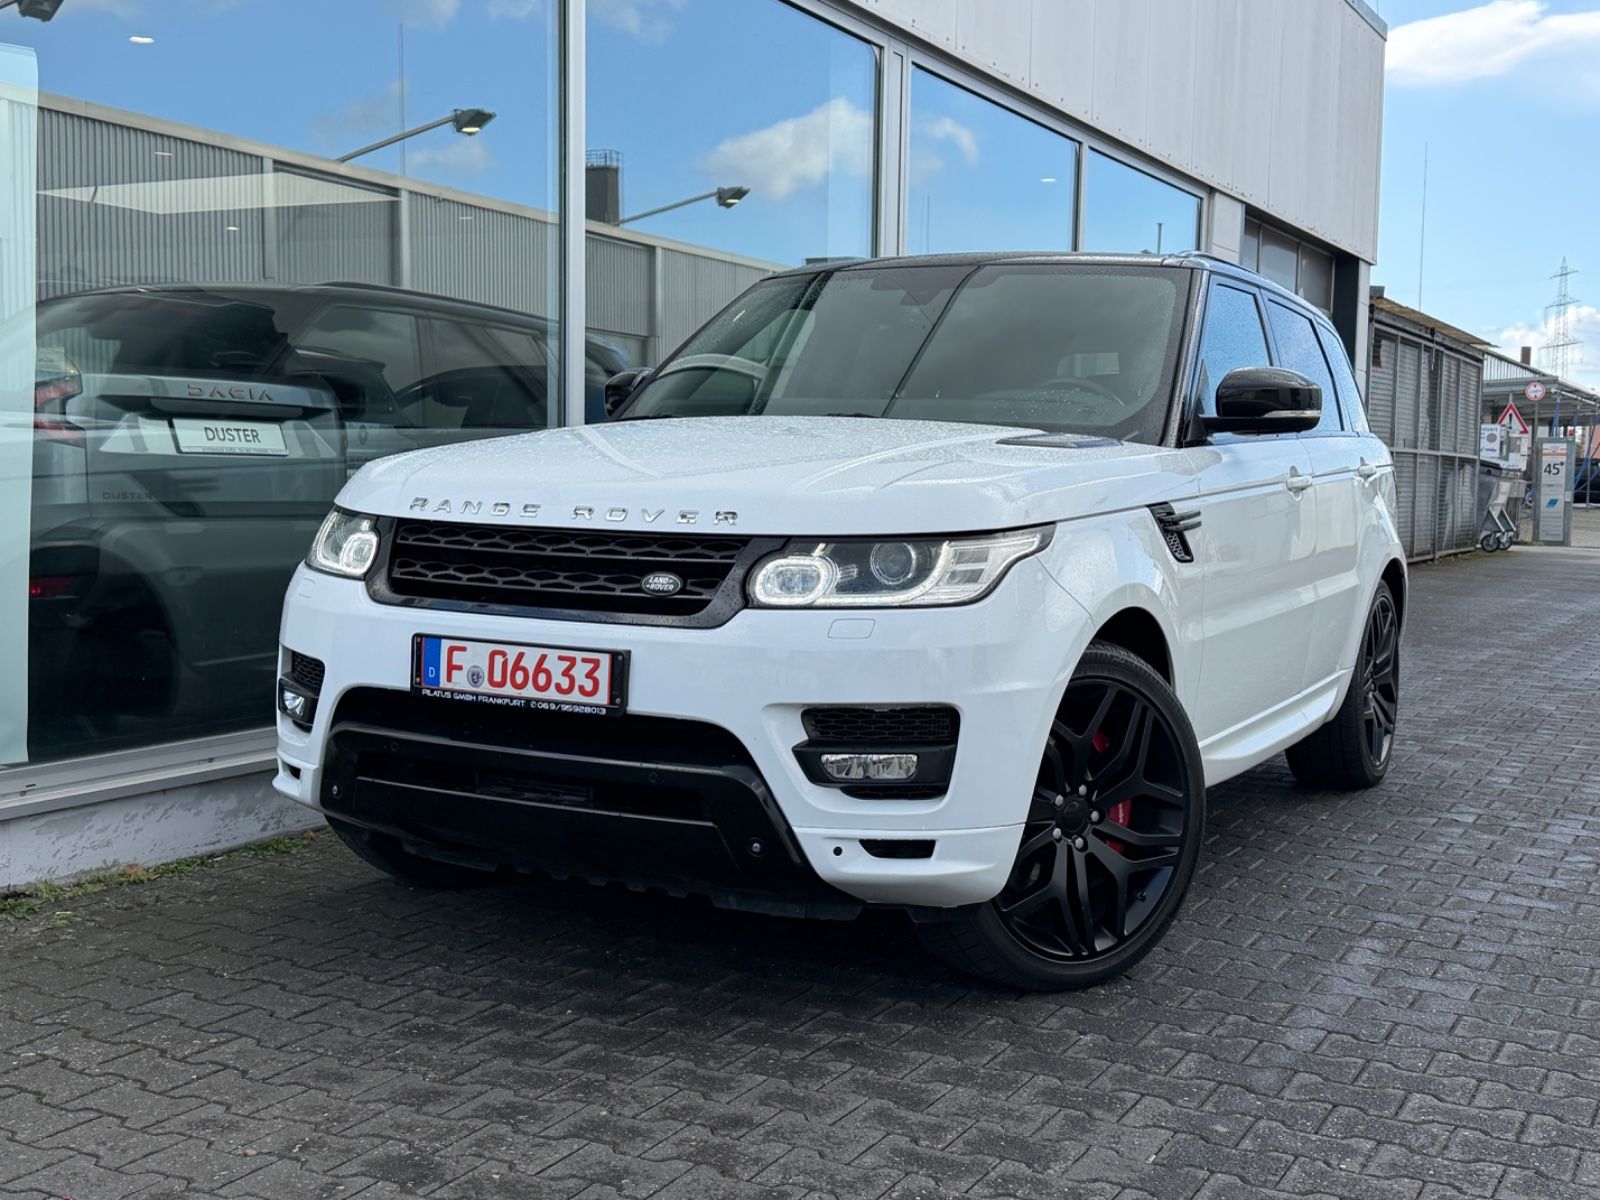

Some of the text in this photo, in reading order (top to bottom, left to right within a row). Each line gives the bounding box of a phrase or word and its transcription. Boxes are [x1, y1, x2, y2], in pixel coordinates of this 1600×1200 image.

[187, 384, 273, 401] DACIA
[204, 426, 262, 444] DUSTER
[102, 491, 153, 500] DUSTER
[408, 496, 739, 526] RANGE ROVER
[428, 666, 436, 678] D
[446, 645, 601, 697] F 06633
[421, 688, 452, 699] PILATUS
[453, 692, 477, 702] GMBH
[478, 696, 525, 708] FRANKFURT
